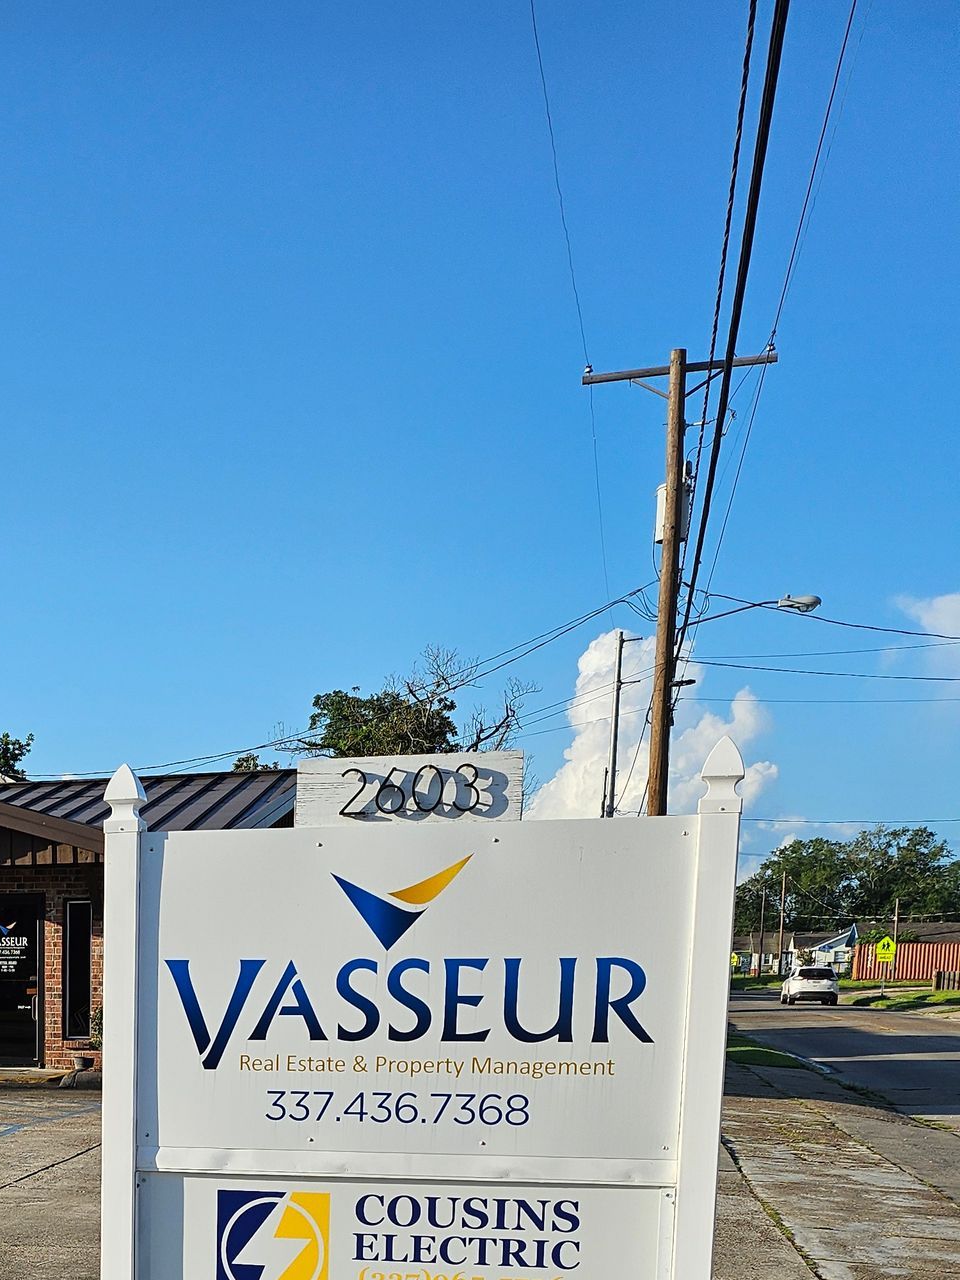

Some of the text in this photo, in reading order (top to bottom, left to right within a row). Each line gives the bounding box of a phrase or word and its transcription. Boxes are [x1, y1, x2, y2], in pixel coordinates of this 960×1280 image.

[338, 762, 480, 816] 2603
[164, 956, 655, 1070] VASSEUR
[239, 1053, 616, 1080] Real Estate & Property Management
[264, 1089, 531, 1126] 337.436.7368
[354, 1193, 581, 1233] COUSINS
[351, 1232, 581, 1270] ELECTRIC
